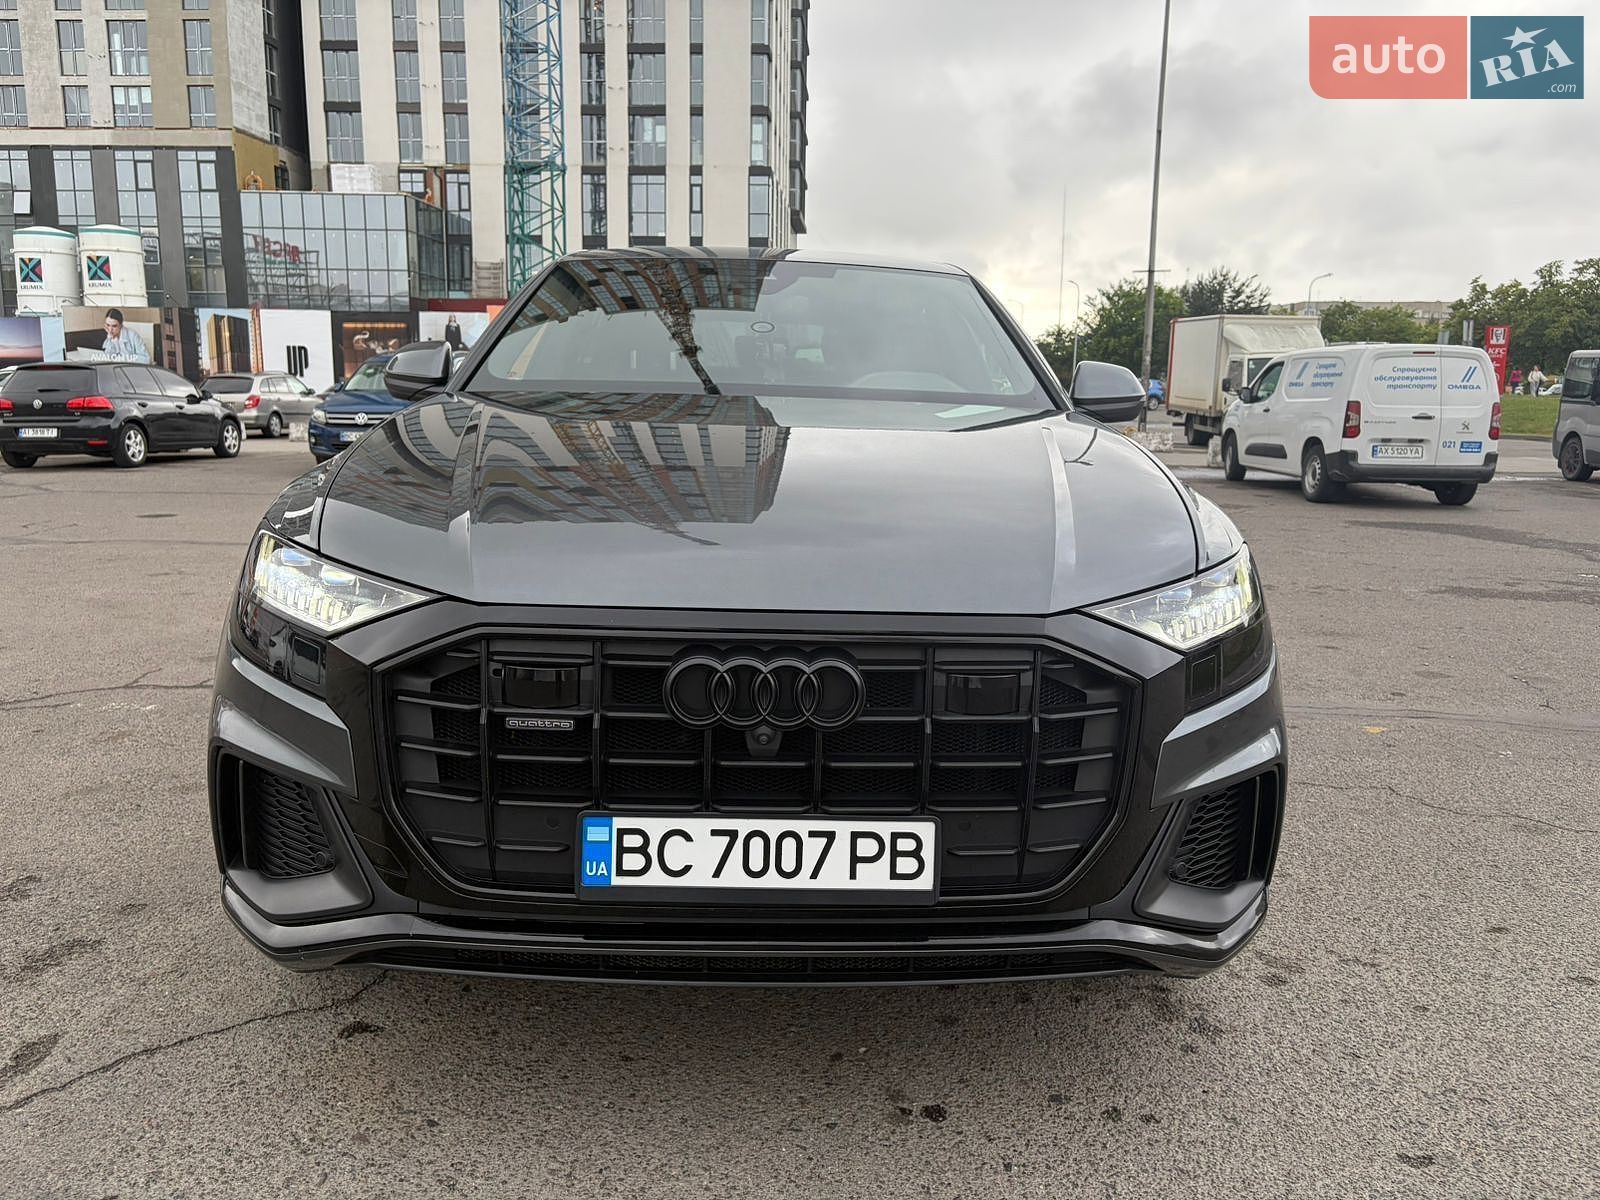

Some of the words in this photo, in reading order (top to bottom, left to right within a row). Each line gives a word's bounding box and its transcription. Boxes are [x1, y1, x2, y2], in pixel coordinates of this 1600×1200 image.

[91, 353, 125, 362] AVALON
[128, 354, 138, 362] UP
[286, 345, 309, 377] UP
[509, 720, 570, 728] quattro
[615, 828, 694, 878] BC
[710, 829, 836, 880] 7007
[849, 830, 926, 881] PB
[585, 861, 608, 876] UA
